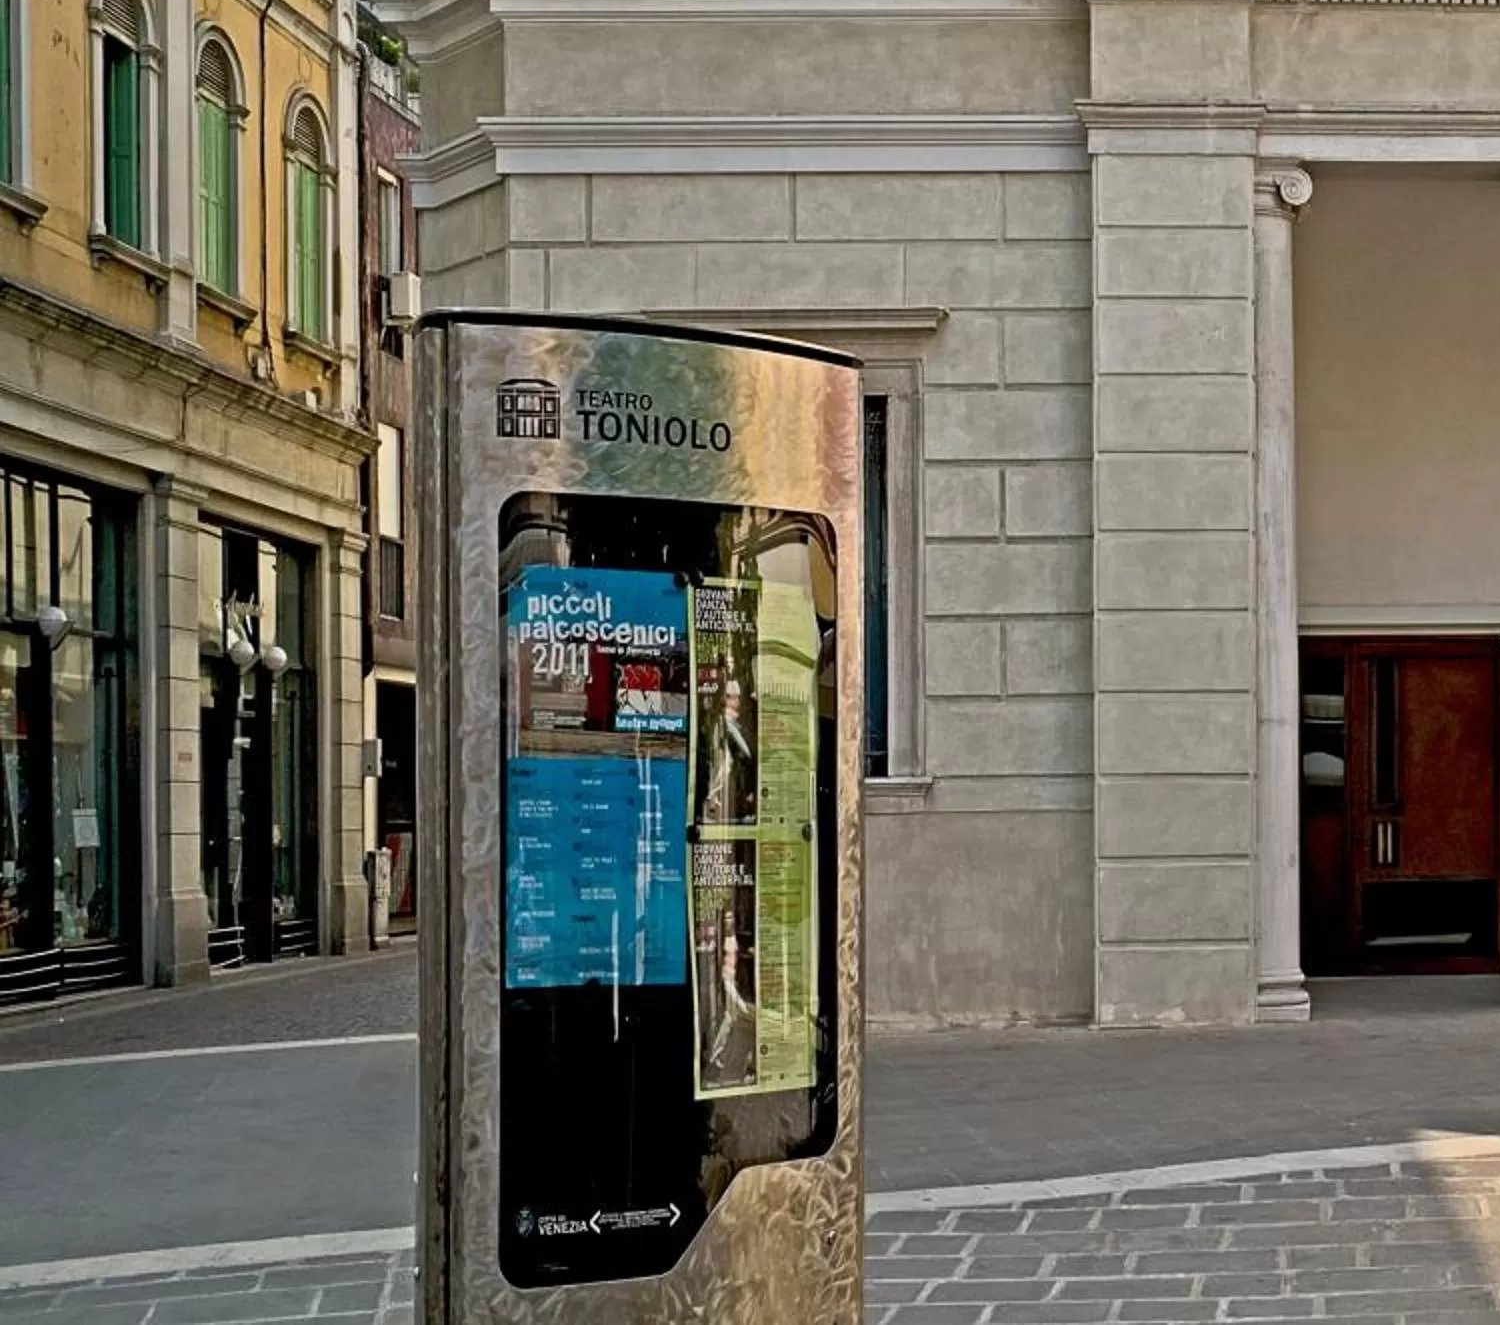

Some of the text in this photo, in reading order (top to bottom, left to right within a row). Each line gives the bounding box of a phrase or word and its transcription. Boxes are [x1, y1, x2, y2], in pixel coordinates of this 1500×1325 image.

[576, 388, 653, 412] TEATRO
[576, 410, 732, 452] TONIOLO
[527, 591, 612, 621] piccoli
[519, 615, 676, 646] palcoscenici
[531, 642, 590, 676] 2011
[538, 1220, 589, 1236] VENEZIA
